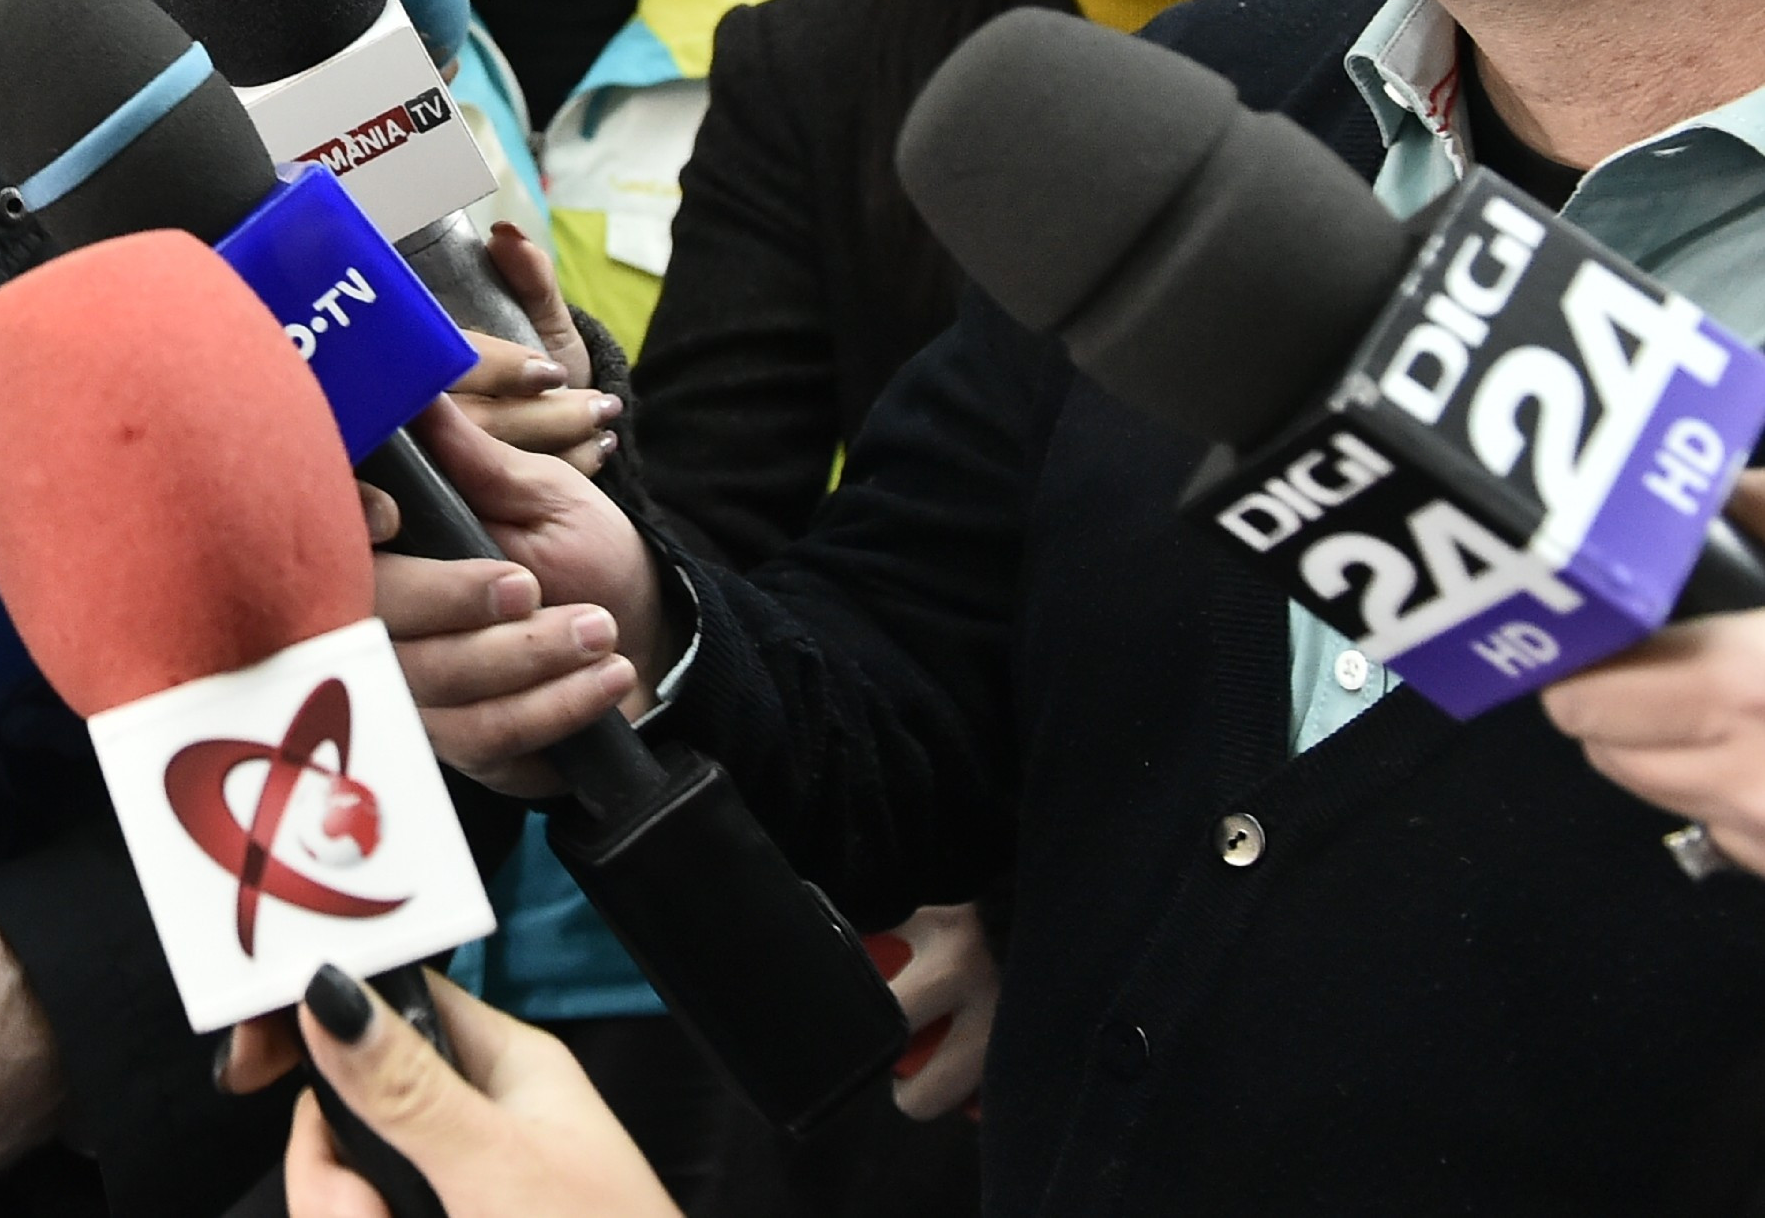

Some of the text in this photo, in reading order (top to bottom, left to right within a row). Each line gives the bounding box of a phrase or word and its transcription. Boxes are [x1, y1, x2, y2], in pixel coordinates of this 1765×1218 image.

[318, 95, 446, 171] MÂNIA TV
[1378, 196, 1547, 425] DIGI
[1466, 257, 1732, 569] 24
[1642, 416, 1726, 516] HD
[1215, 432, 1395, 554] DIGI
[1299, 497, 1586, 665] 24
[1472, 619, 1560, 679] HD
